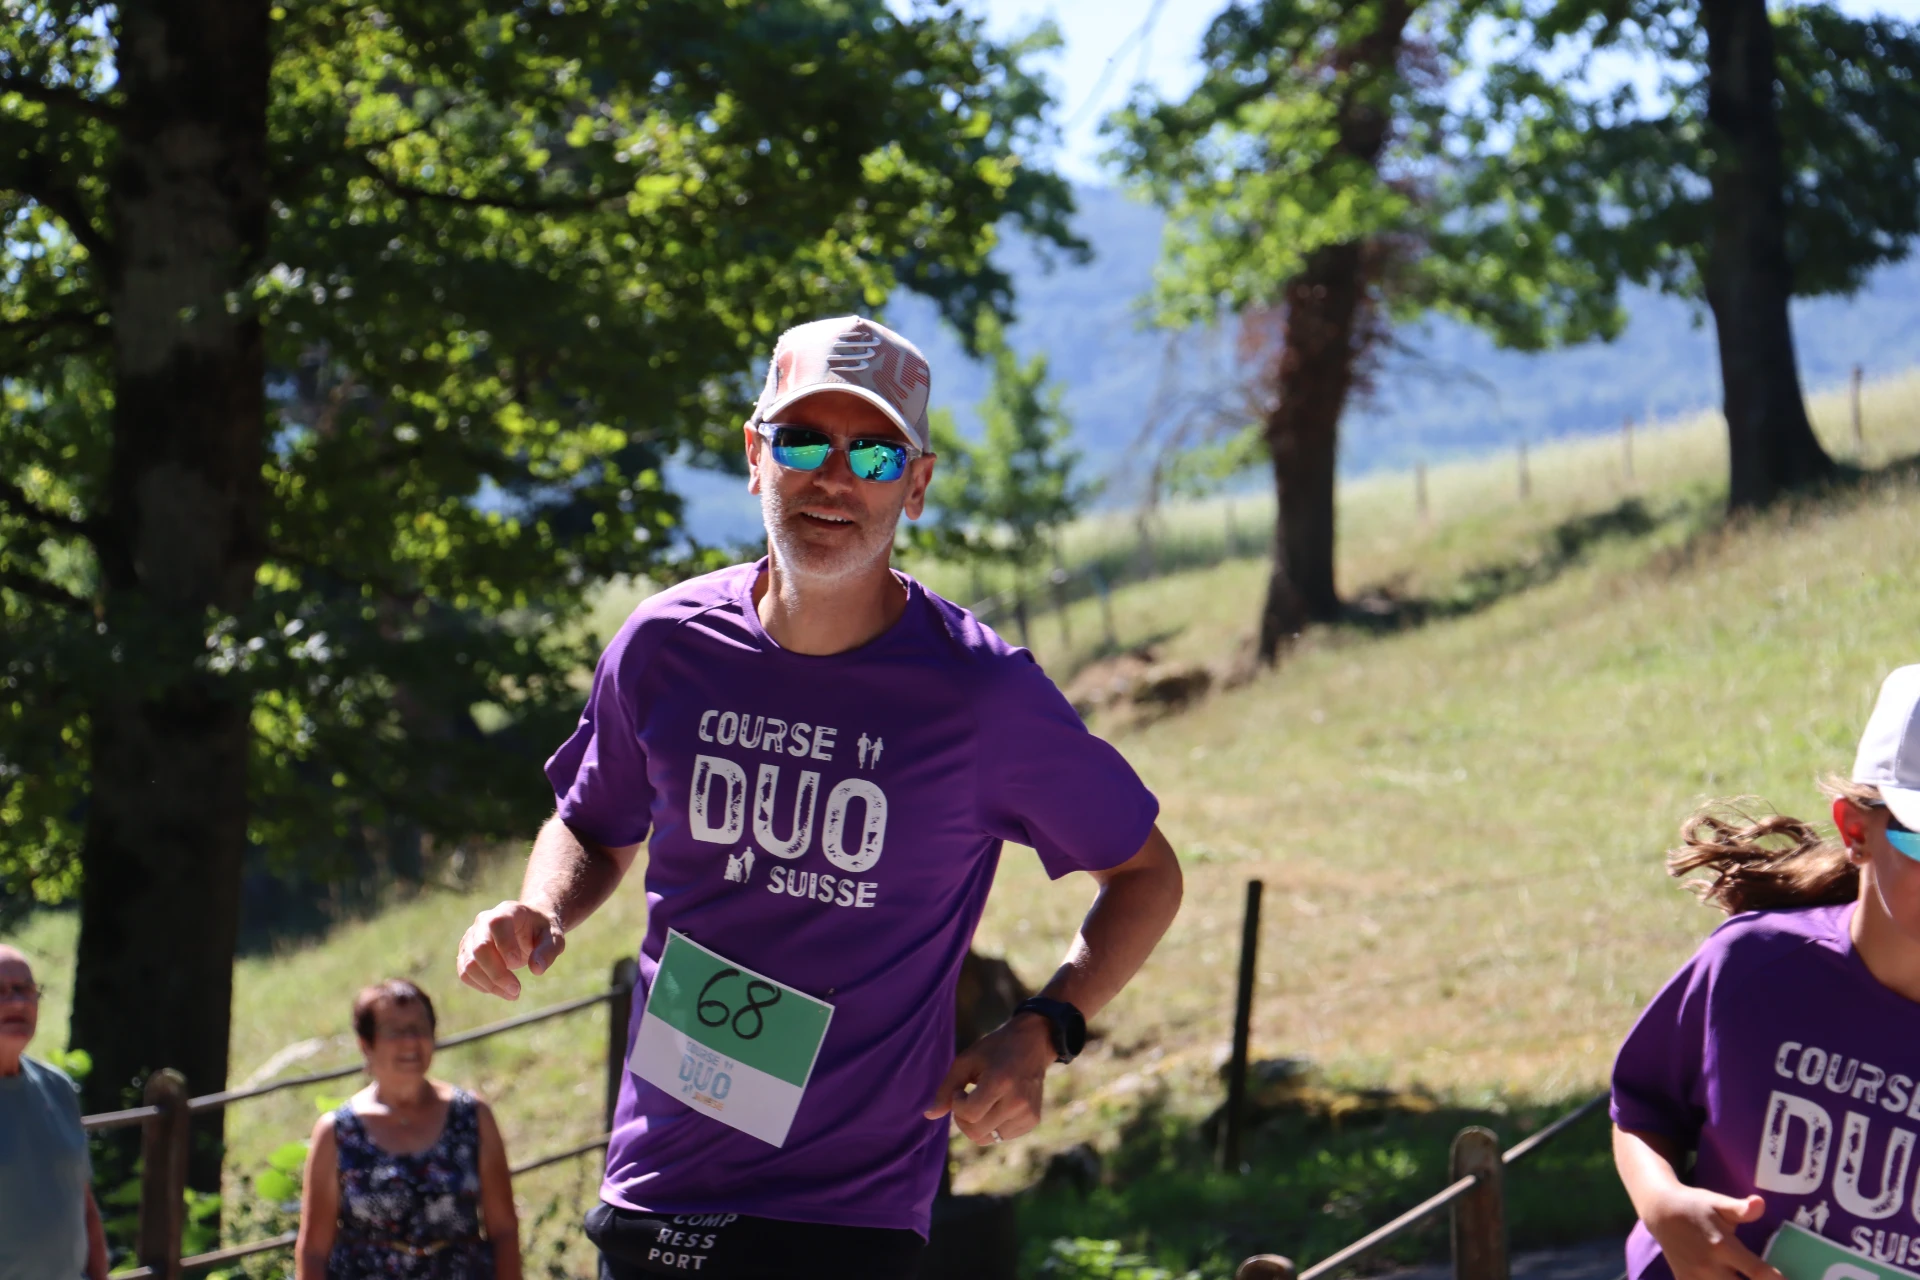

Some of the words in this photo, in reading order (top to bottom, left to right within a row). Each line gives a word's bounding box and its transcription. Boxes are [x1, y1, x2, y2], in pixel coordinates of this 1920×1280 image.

[698, 709, 838, 761] COURSE
[689, 754, 888, 873] DUO
[766, 865, 879, 908] SUISSE
[697, 968, 782, 1040] 68
[679, 1053, 732, 1100] DUO
[1755, 1089, 1920, 1221] DU
[656, 1227, 717, 1249] RESS
[673, 1213, 738, 1228] COMP
[648, 1248, 707, 1270] PORT
